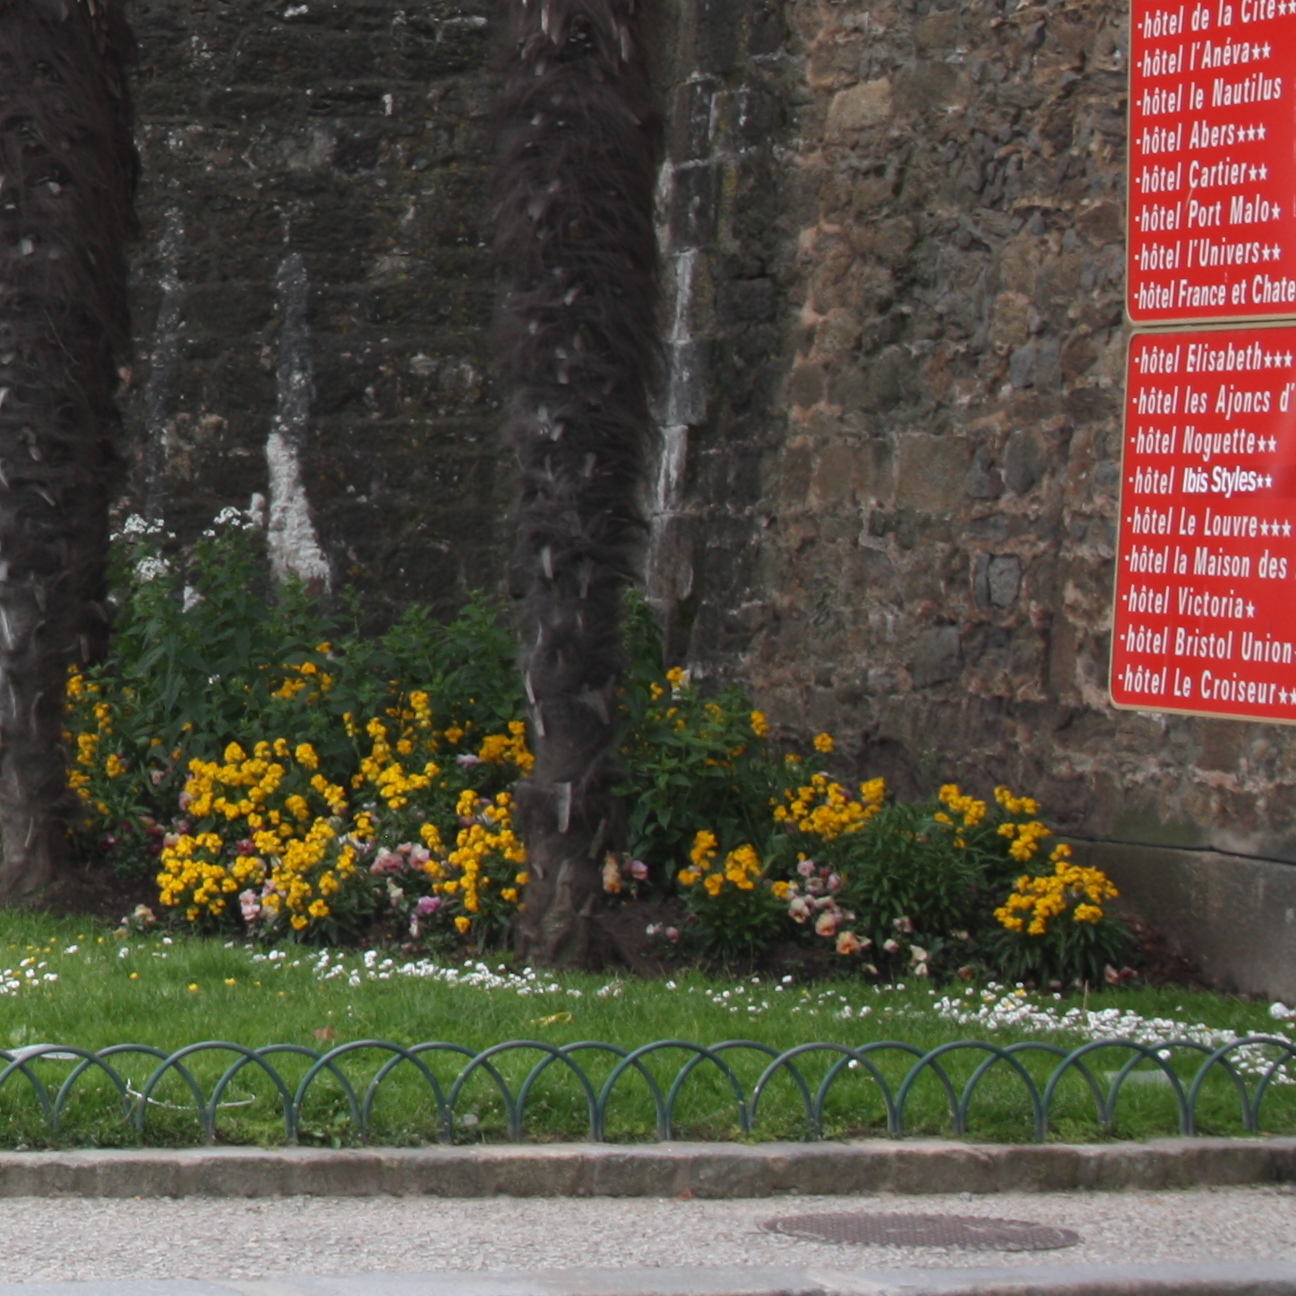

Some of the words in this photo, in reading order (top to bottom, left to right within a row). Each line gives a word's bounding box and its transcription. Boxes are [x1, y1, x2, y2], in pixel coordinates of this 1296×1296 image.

[1191, 2, 1210, 32] de
[1189, 37, 1250, 71] l'Anéva
[1189, 81, 1204, 110] le
[1211, 72, 1282, 107] Nautilus
[1188, 119, 1236, 150] Abers
[1188, 156, 1247, 189] Cartier
[1187, 199, 1222, 229] Port
[1229, 193, 1270, 225] Malo
[1187, 236, 1260, 268] l'Univers
[1177, 278, 1227, 308] France
[1231, 279, 1247, 305] et
[1252, 273, 1296, 304] Chate
[1185, 341, 1262, 373] Elisabeth
[1184, 385, 1208, 414] les
[1214, 384, 1271, 421] Ajoncs
[1182, 425, 1256, 463] Noguette
[1182, 466, 1209, 494] Ibis
[1210, 465, 1258, 499] Styles
[1178, 506, 1196, 536] Le
[1203, 507, 1258, 538] Louvre
[1173, 545, 1188, 575] la
[1193, 546, 1251, 578] Maison
[1258, 548, 1288, 580] des
[1178, 586, 1244, 619] Victoria
[1174, 626, 1233, 660] Bristol
[1241, 631, 1292, 664] Union
[1173, 667, 1192, 698] Le
[1200, 669, 1277, 705] Croiseur
